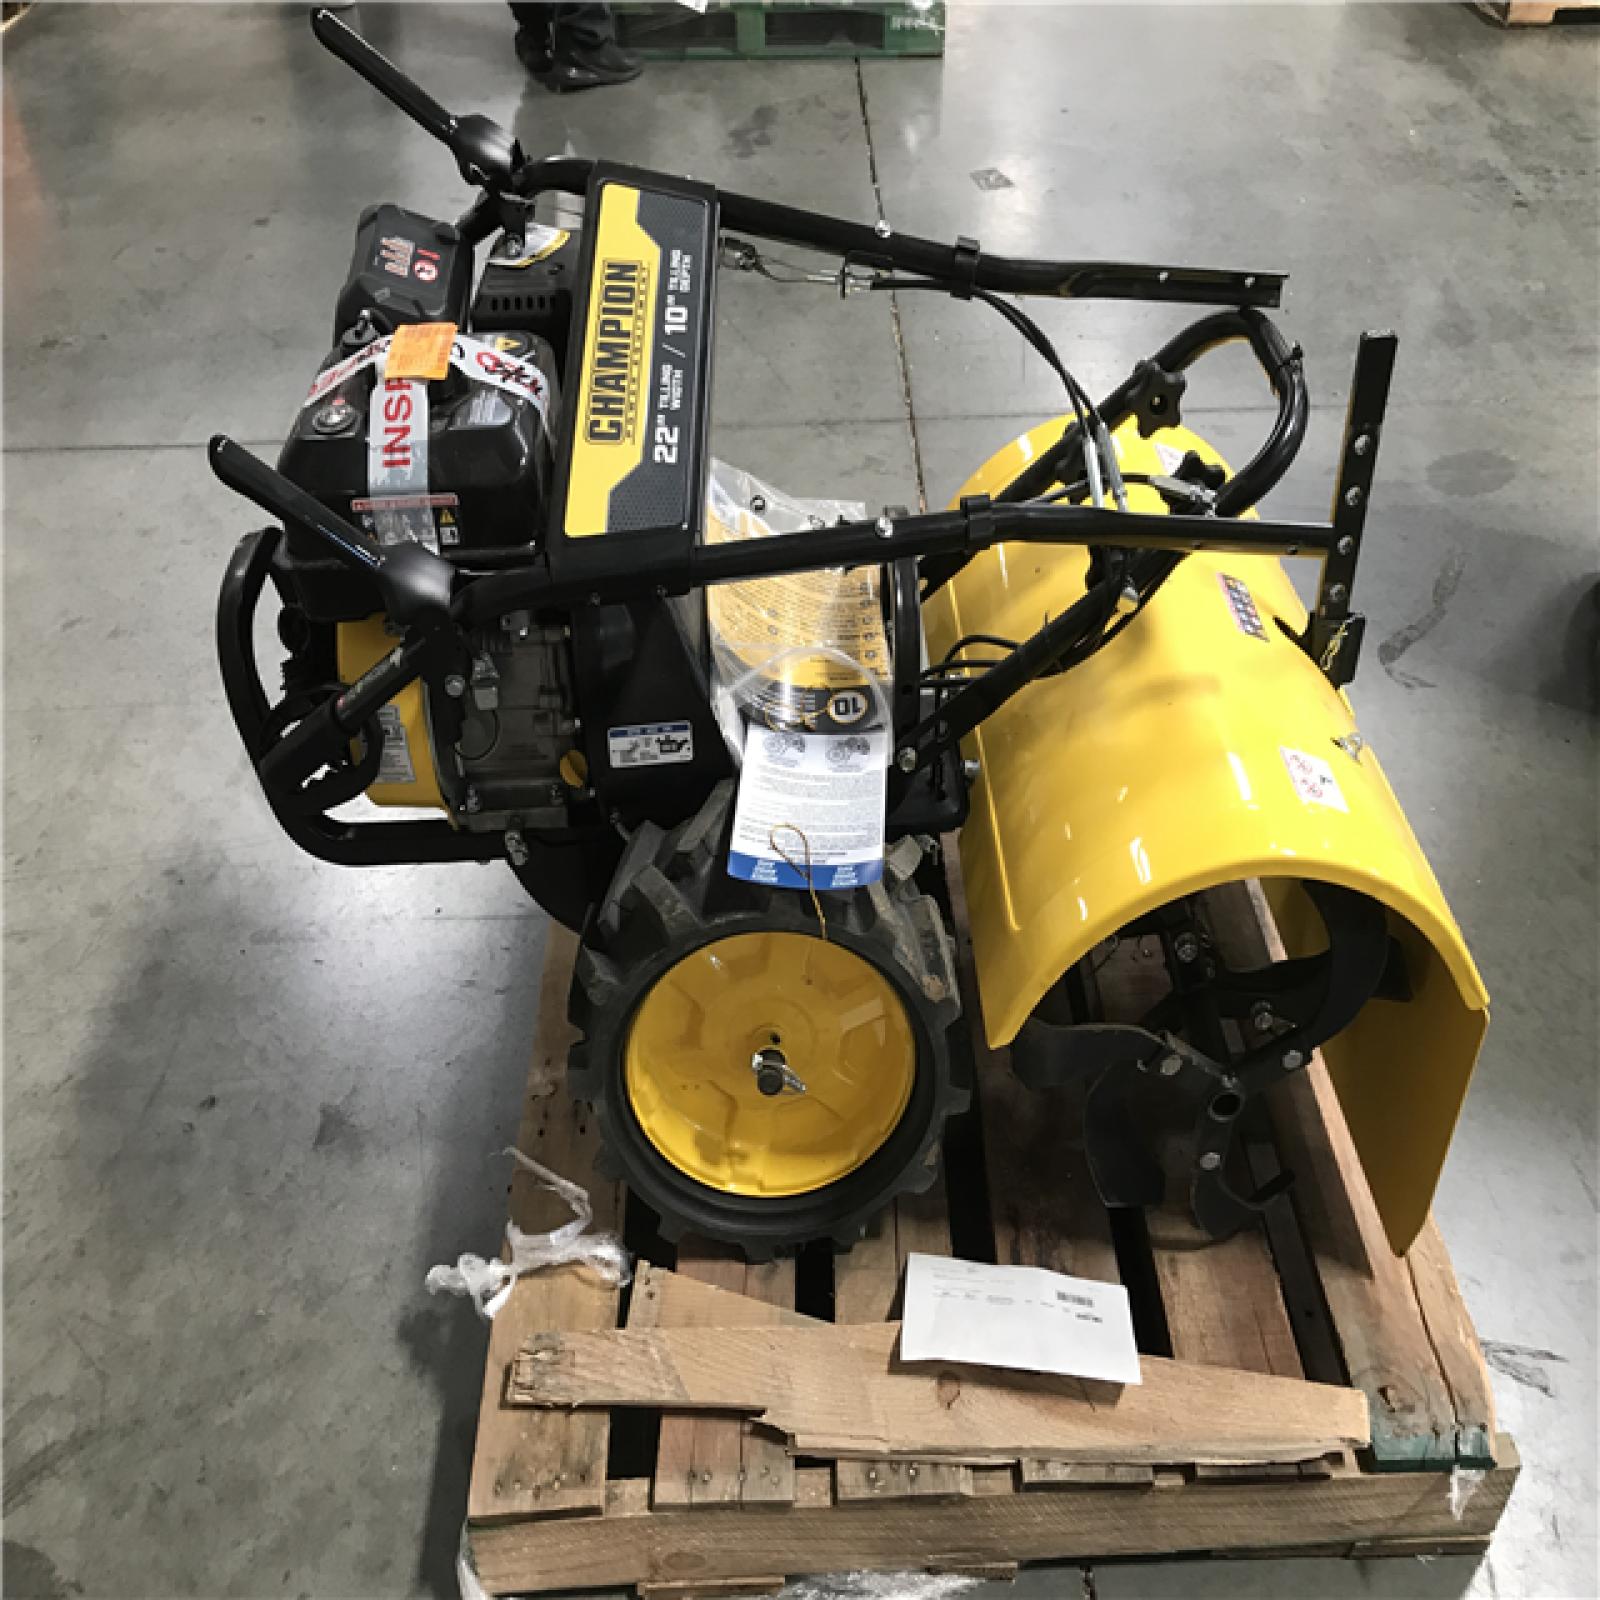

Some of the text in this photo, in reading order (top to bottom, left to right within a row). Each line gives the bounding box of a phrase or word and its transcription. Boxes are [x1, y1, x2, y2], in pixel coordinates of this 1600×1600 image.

[666, 294, 688, 336] 10"
[588, 262, 639, 441] CHAMPION
[654, 414, 679, 464] 22"
[833, 696, 863, 717] 10
